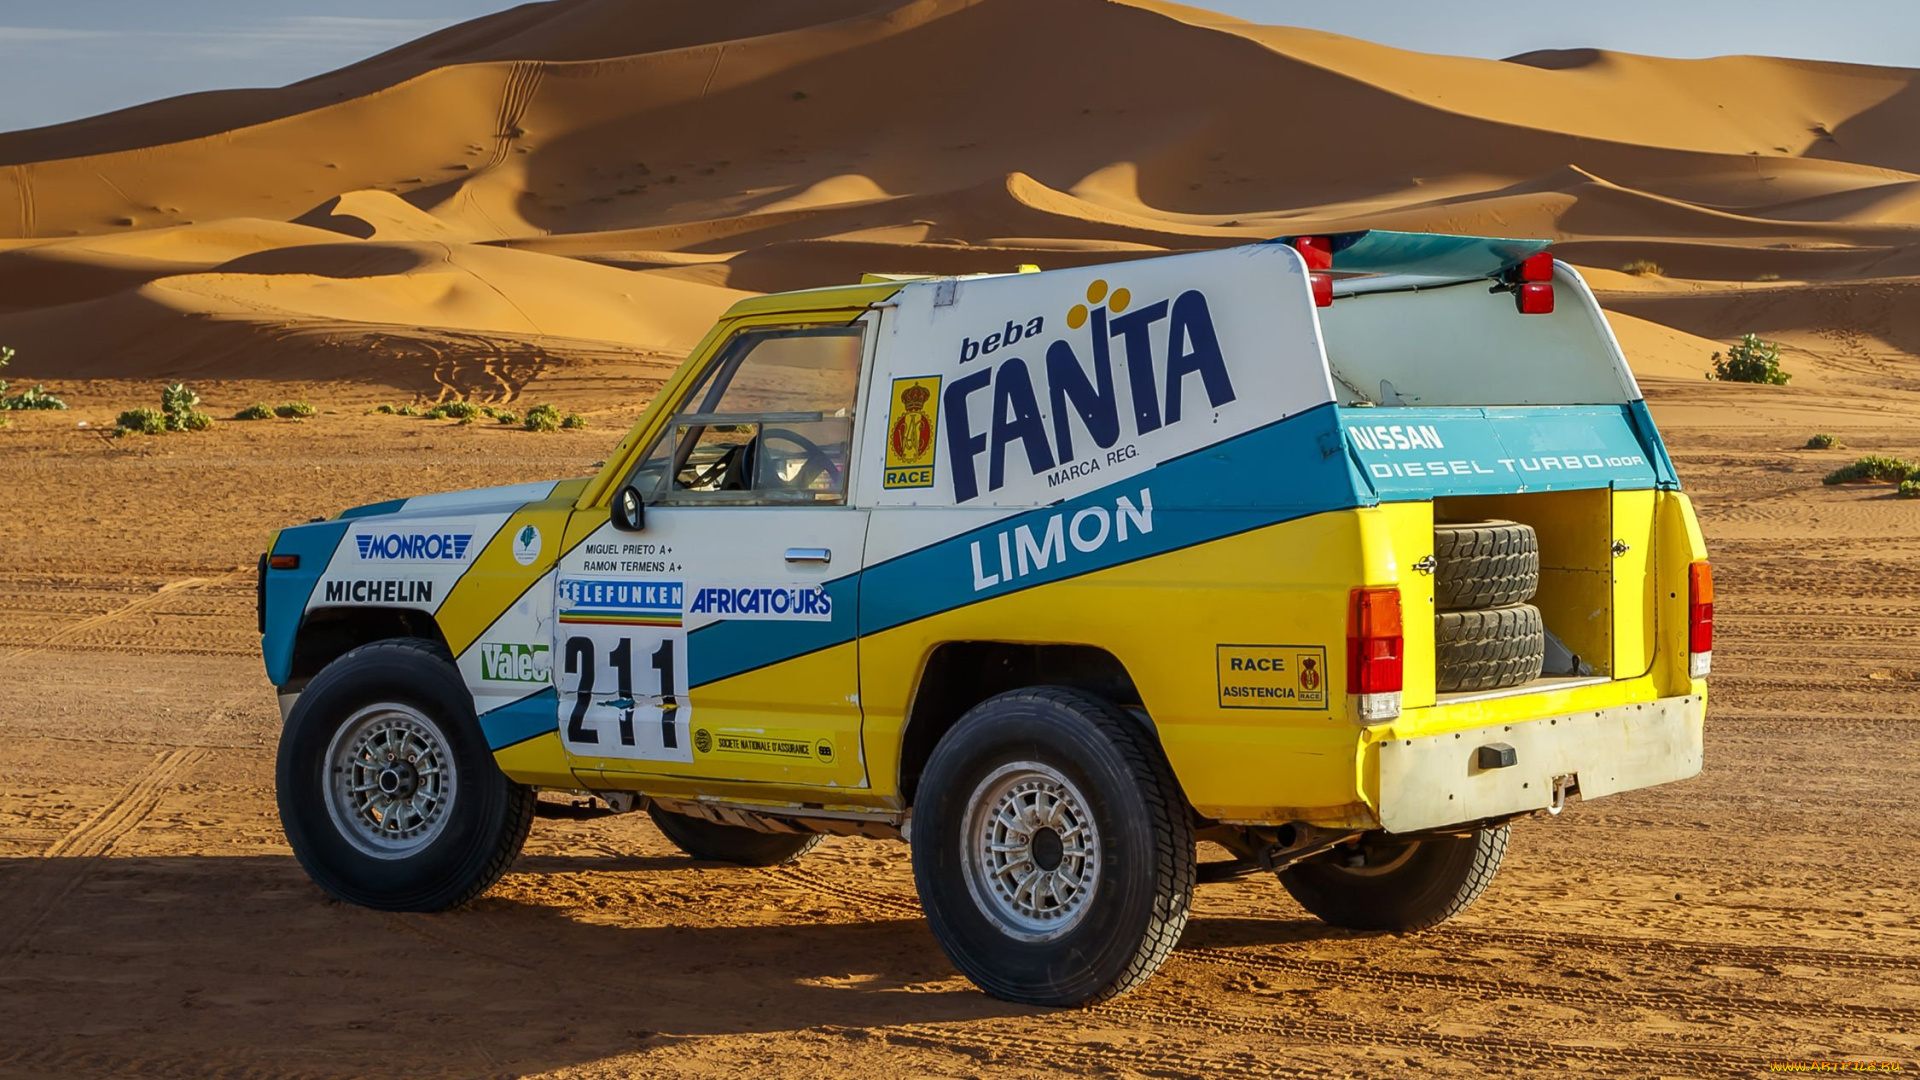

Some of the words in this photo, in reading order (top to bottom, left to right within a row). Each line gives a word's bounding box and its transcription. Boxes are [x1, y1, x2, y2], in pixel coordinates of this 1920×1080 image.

[959, 315, 1044, 365] beba
[943, 289, 1237, 505] FANTA
[1349, 425, 1444, 450] NISSAN
[887, 470, 931, 485] RACE
[1047, 461, 1101, 488] MARCA
[1107, 443, 1140, 467] REG.
[1370, 460, 1494, 479] DIESEL
[1498, 454, 1601, 472] TURBO
[369, 534, 454, 560] MONROE
[585, 544, 619, 555] MIGUEL
[622, 544, 656, 555] PRIETO
[970, 487, 1153, 592] LIMON
[583, 561, 618, 572] RAMON
[620, 562, 665, 573] TERMENS
[325, 580, 433, 603] MICHELIN
[560, 582, 682, 605] TELEFUNKEN
[689, 587, 832, 615] AFRICATOURS
[1230, 658, 1285, 671] RACE
[564, 635, 678, 749] 211
[1223, 686, 1296, 699] ASISTENCIA
[740, 740, 772, 752] NATIONALE
